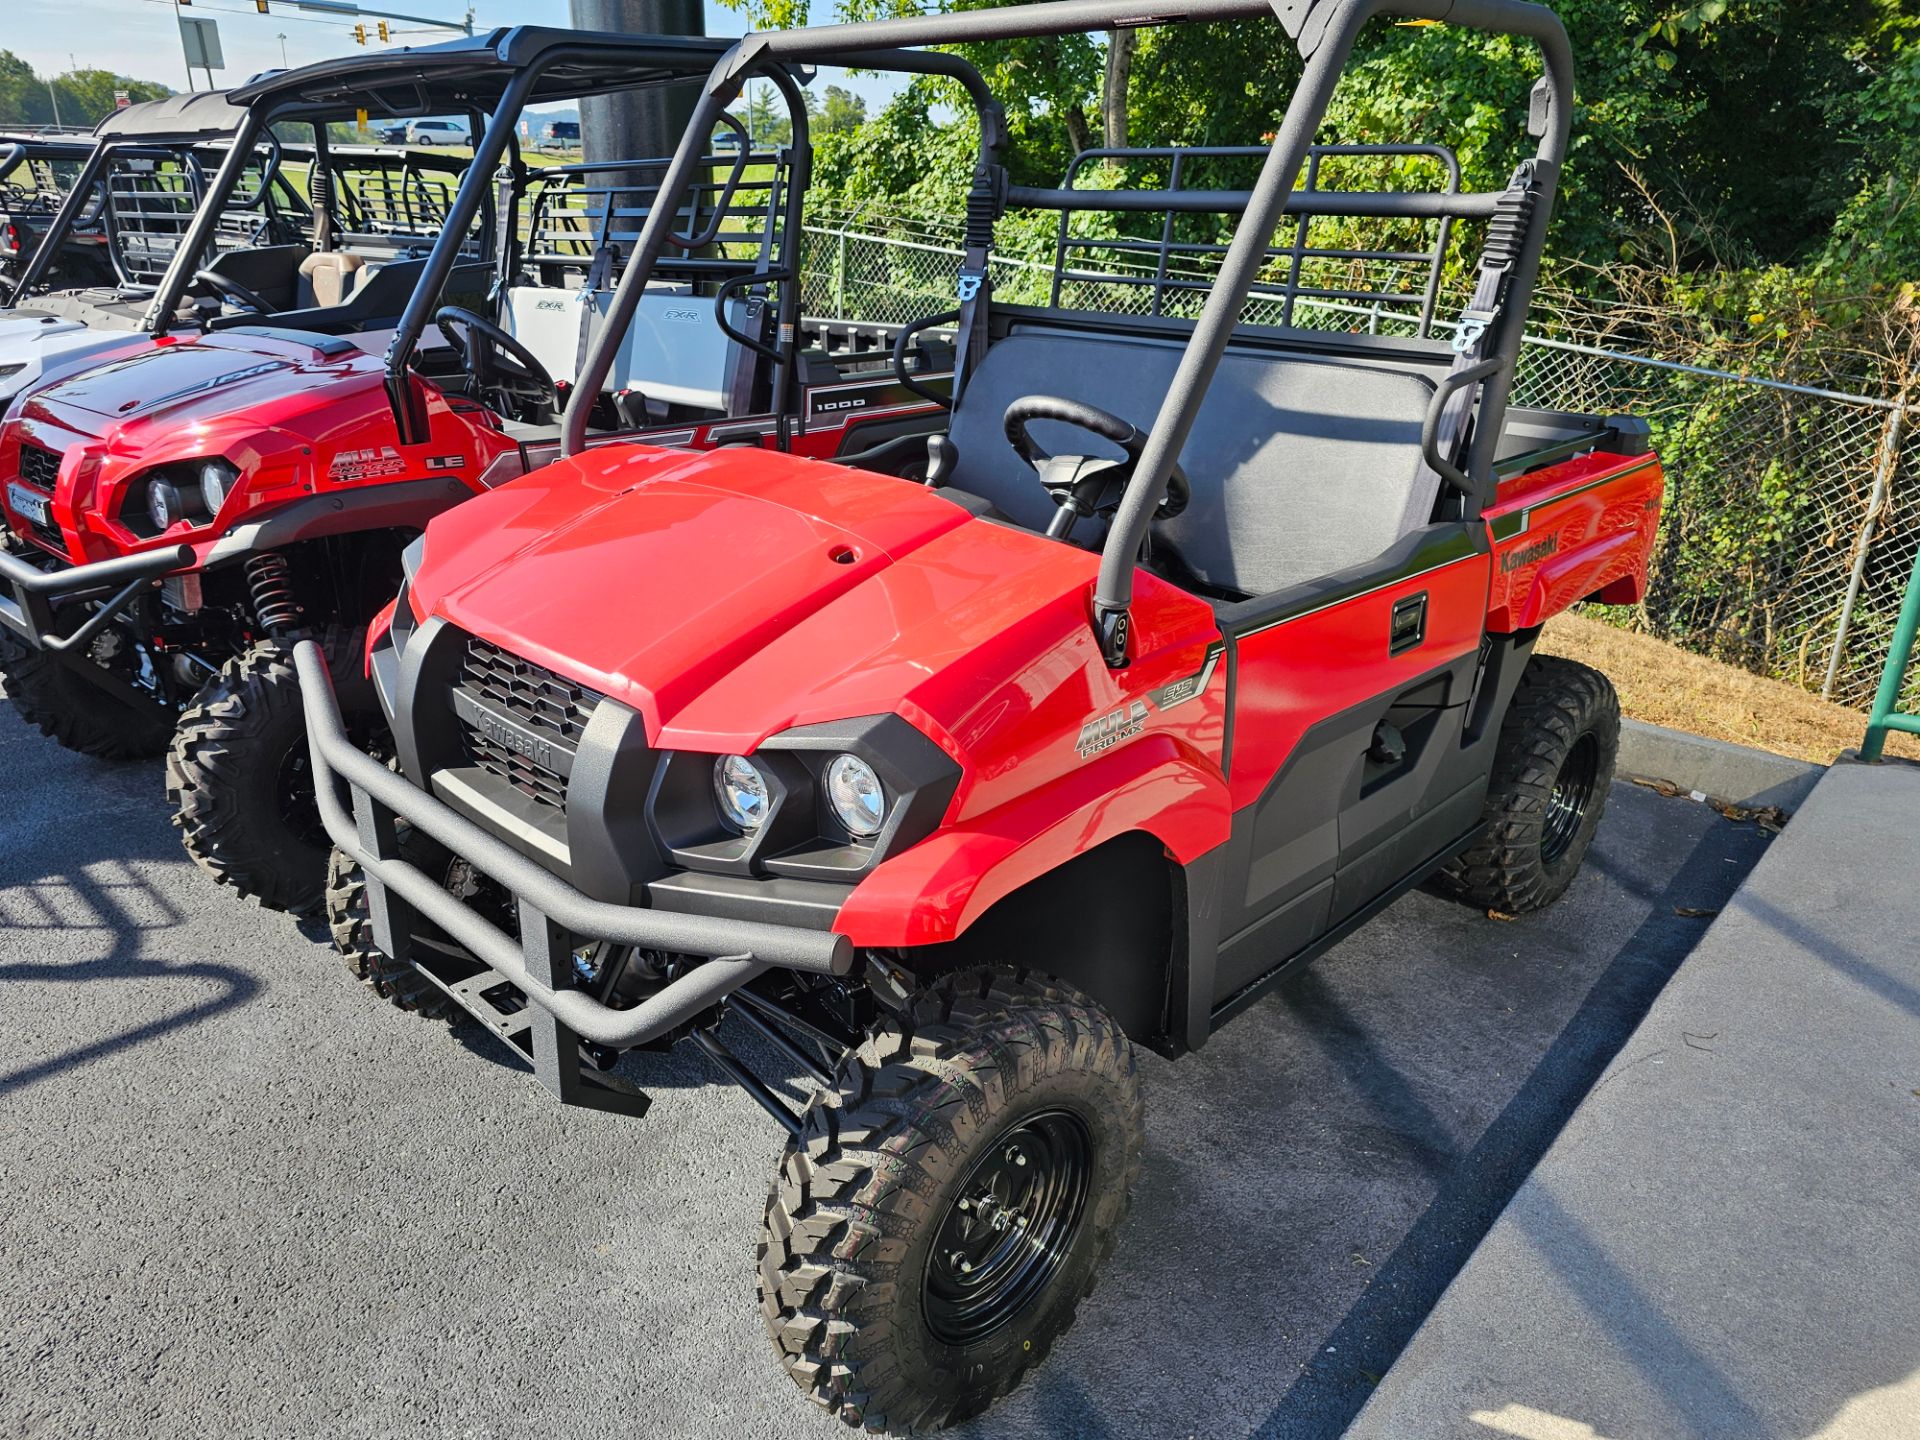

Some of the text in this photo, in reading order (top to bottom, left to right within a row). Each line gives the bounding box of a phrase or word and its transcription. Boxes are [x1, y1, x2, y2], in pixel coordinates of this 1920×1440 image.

[816, 399, 866, 411] 1000
[425, 456, 464, 470] LE
[1500, 531, 1559, 573] Kawasaki
[473, 704, 552, 768] Kawasaki
